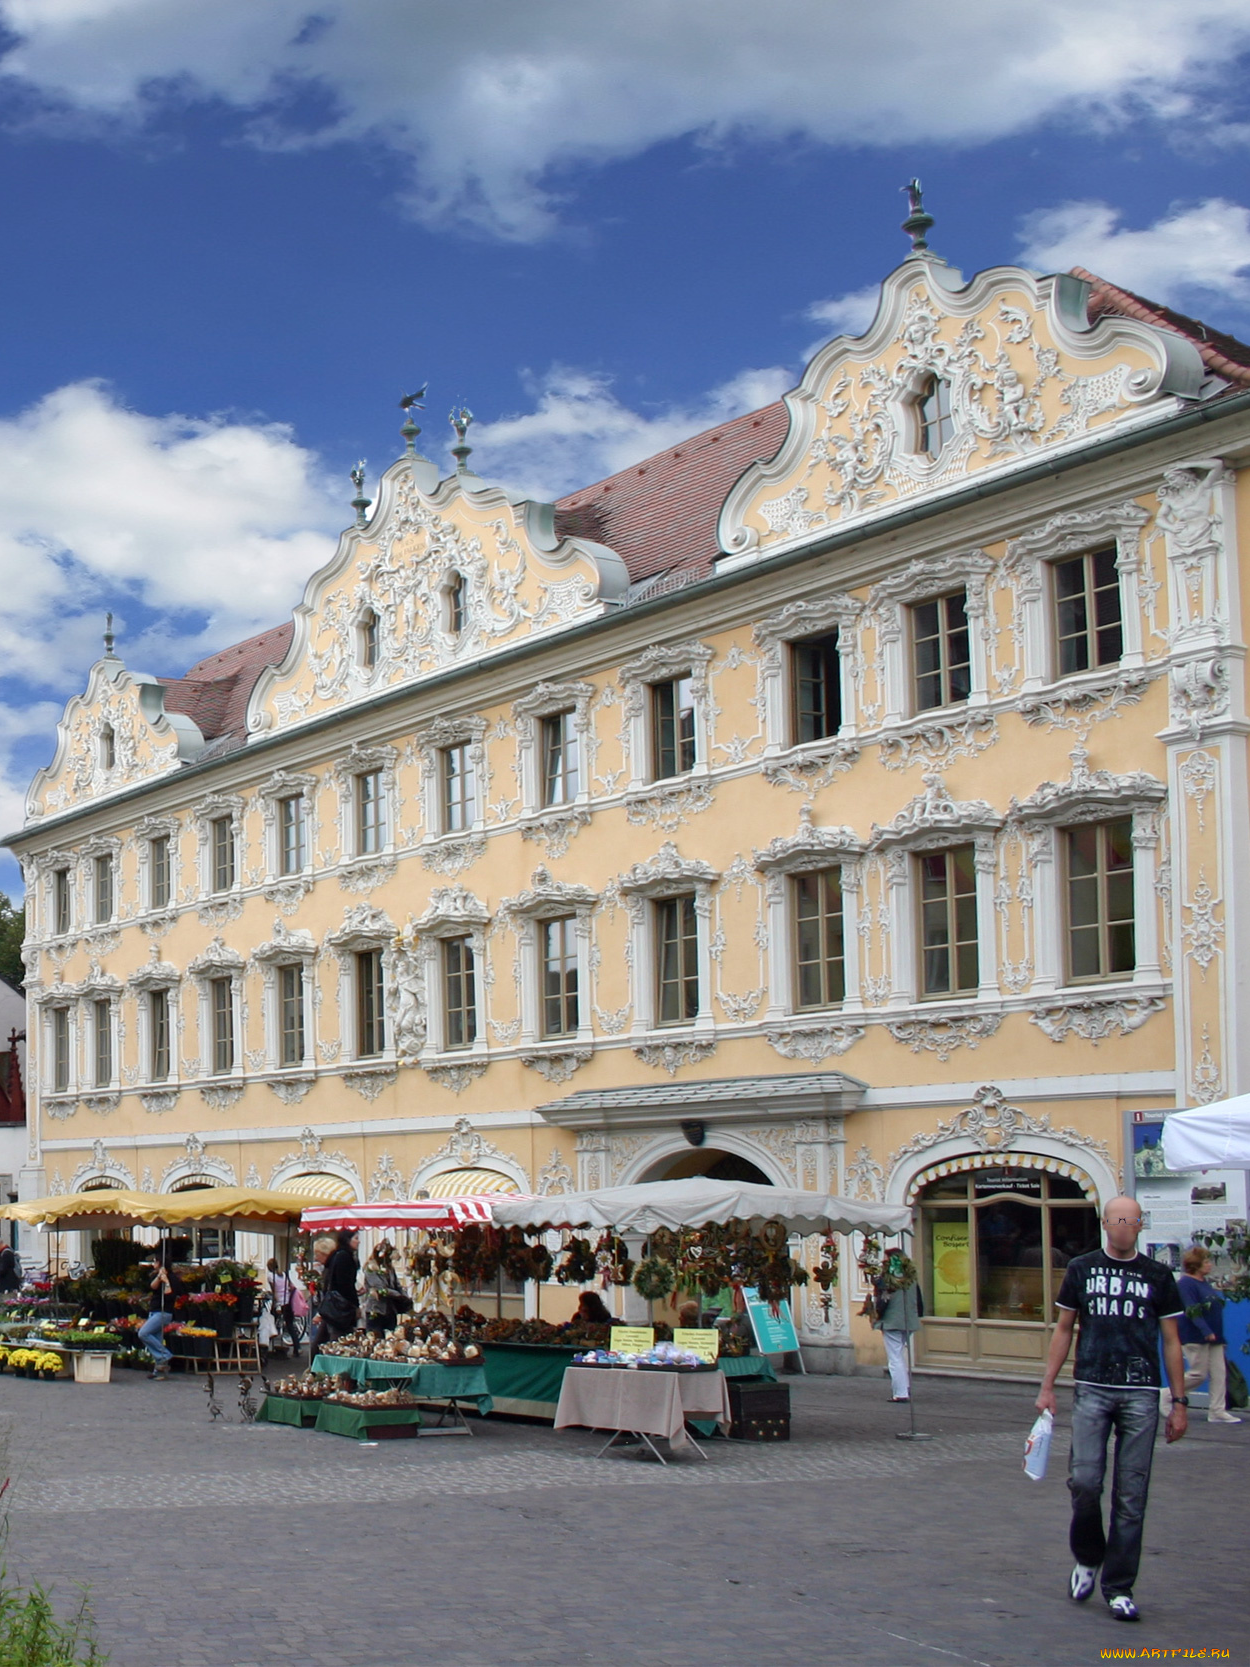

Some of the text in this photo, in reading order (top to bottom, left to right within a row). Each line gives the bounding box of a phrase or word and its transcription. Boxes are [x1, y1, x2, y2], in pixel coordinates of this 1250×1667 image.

[1090, 1267, 1124, 1276] DRIVE
[1086, 1276, 1149, 1298] URBAN
[1088, 1297, 1145, 1319] CHAOS
